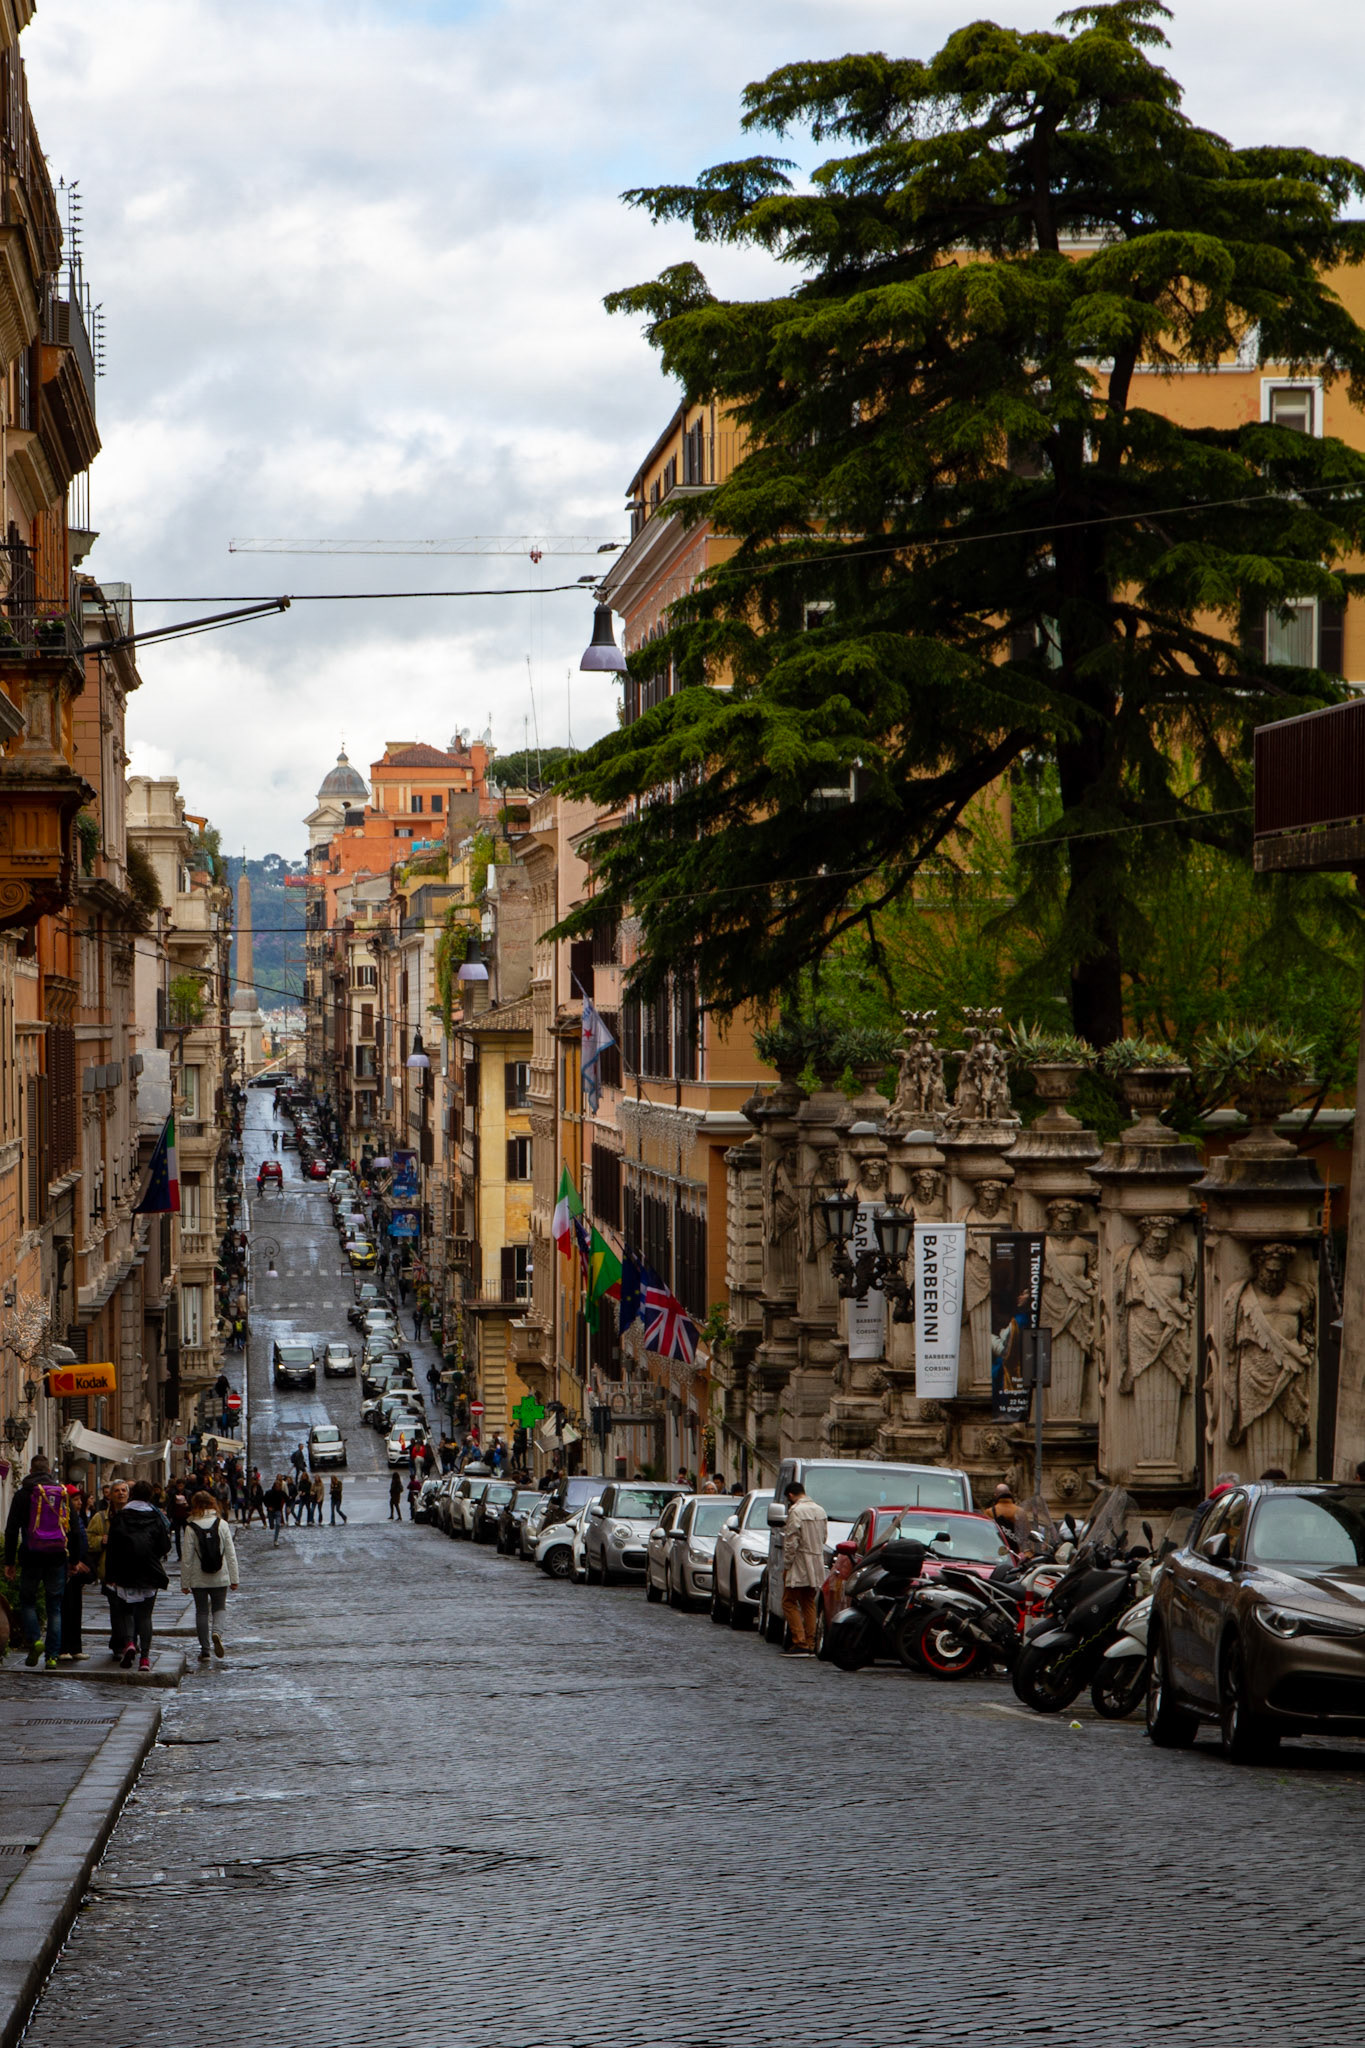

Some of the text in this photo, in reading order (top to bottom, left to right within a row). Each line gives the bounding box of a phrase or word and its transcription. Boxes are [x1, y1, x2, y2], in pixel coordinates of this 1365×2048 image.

[942, 1234, 958, 1316] PALAZZO
[1030, 1242, 1041, 1254] IL
[923, 1235, 938, 1343] BARBERINI
[1030, 1256, 1041, 1311] TRIONFO
[76, 1376, 108, 1390] Kodak
